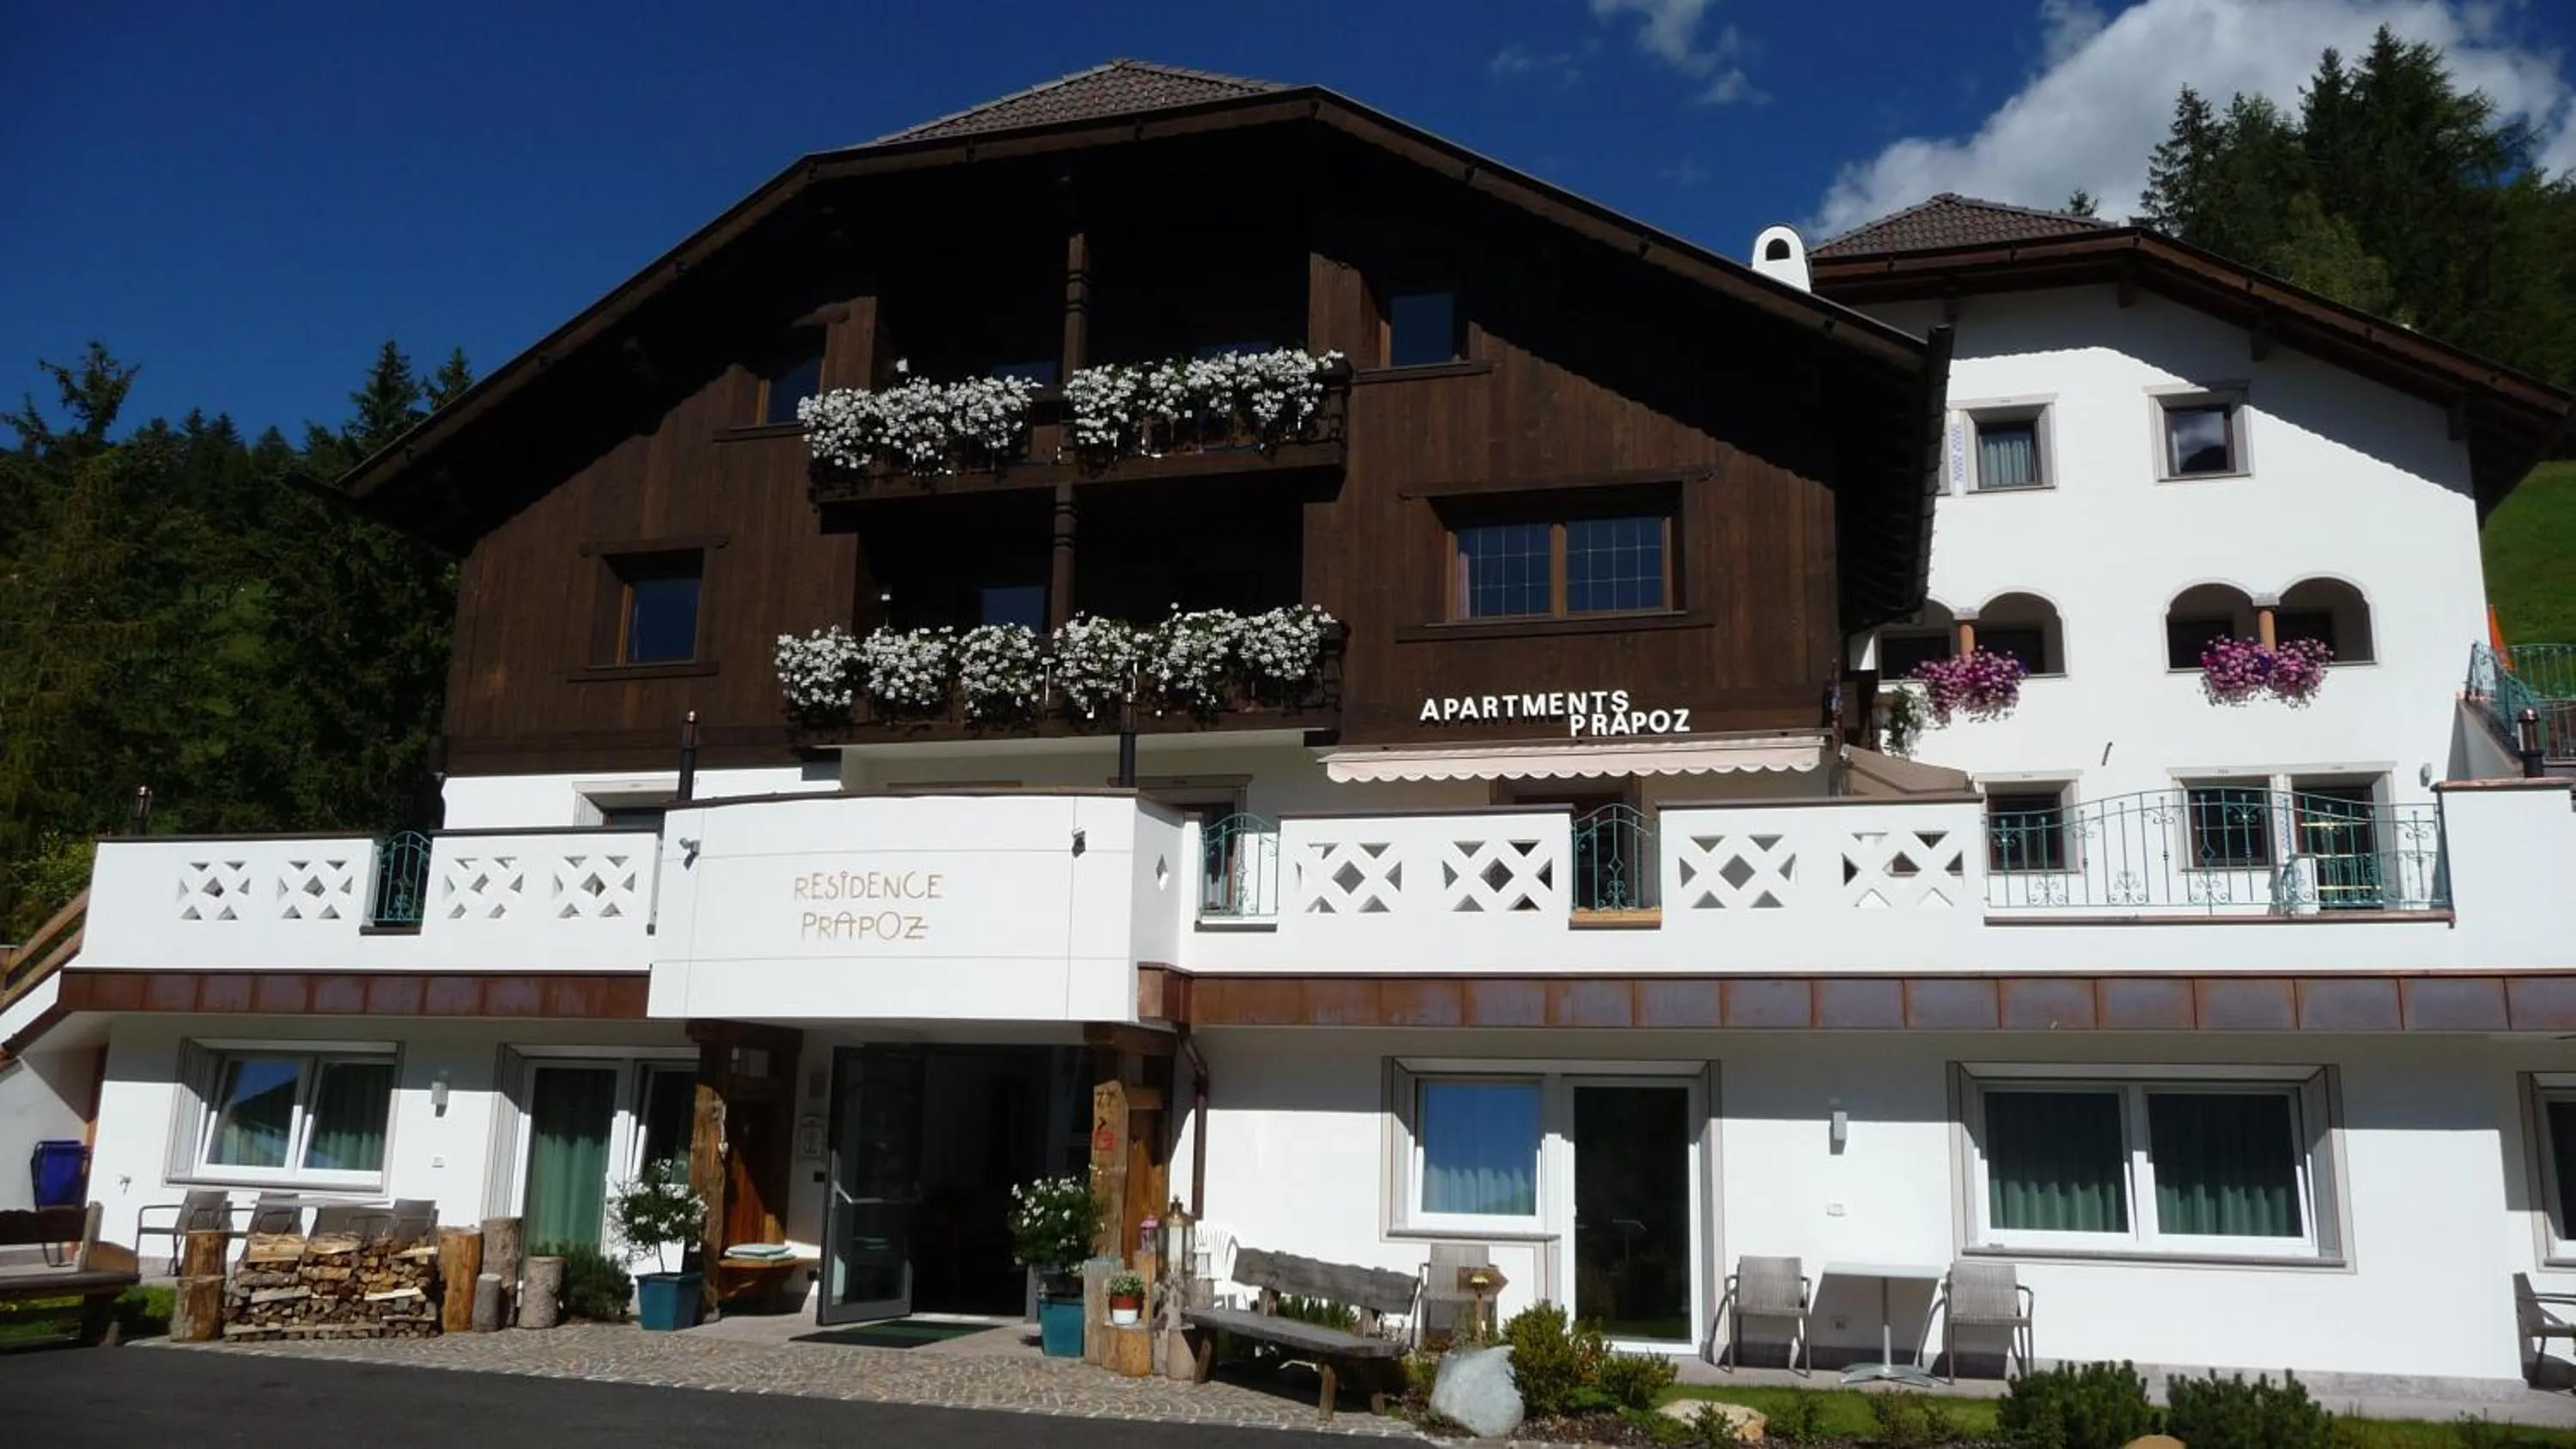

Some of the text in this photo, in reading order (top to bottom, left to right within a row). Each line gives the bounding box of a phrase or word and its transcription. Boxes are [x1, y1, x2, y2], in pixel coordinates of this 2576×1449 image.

[1419, 690, 1629, 721] APARTMENTS
[1571, 709, 1690, 737] PRAPOZ
[801, 911, 929, 940] PRAPOZ
